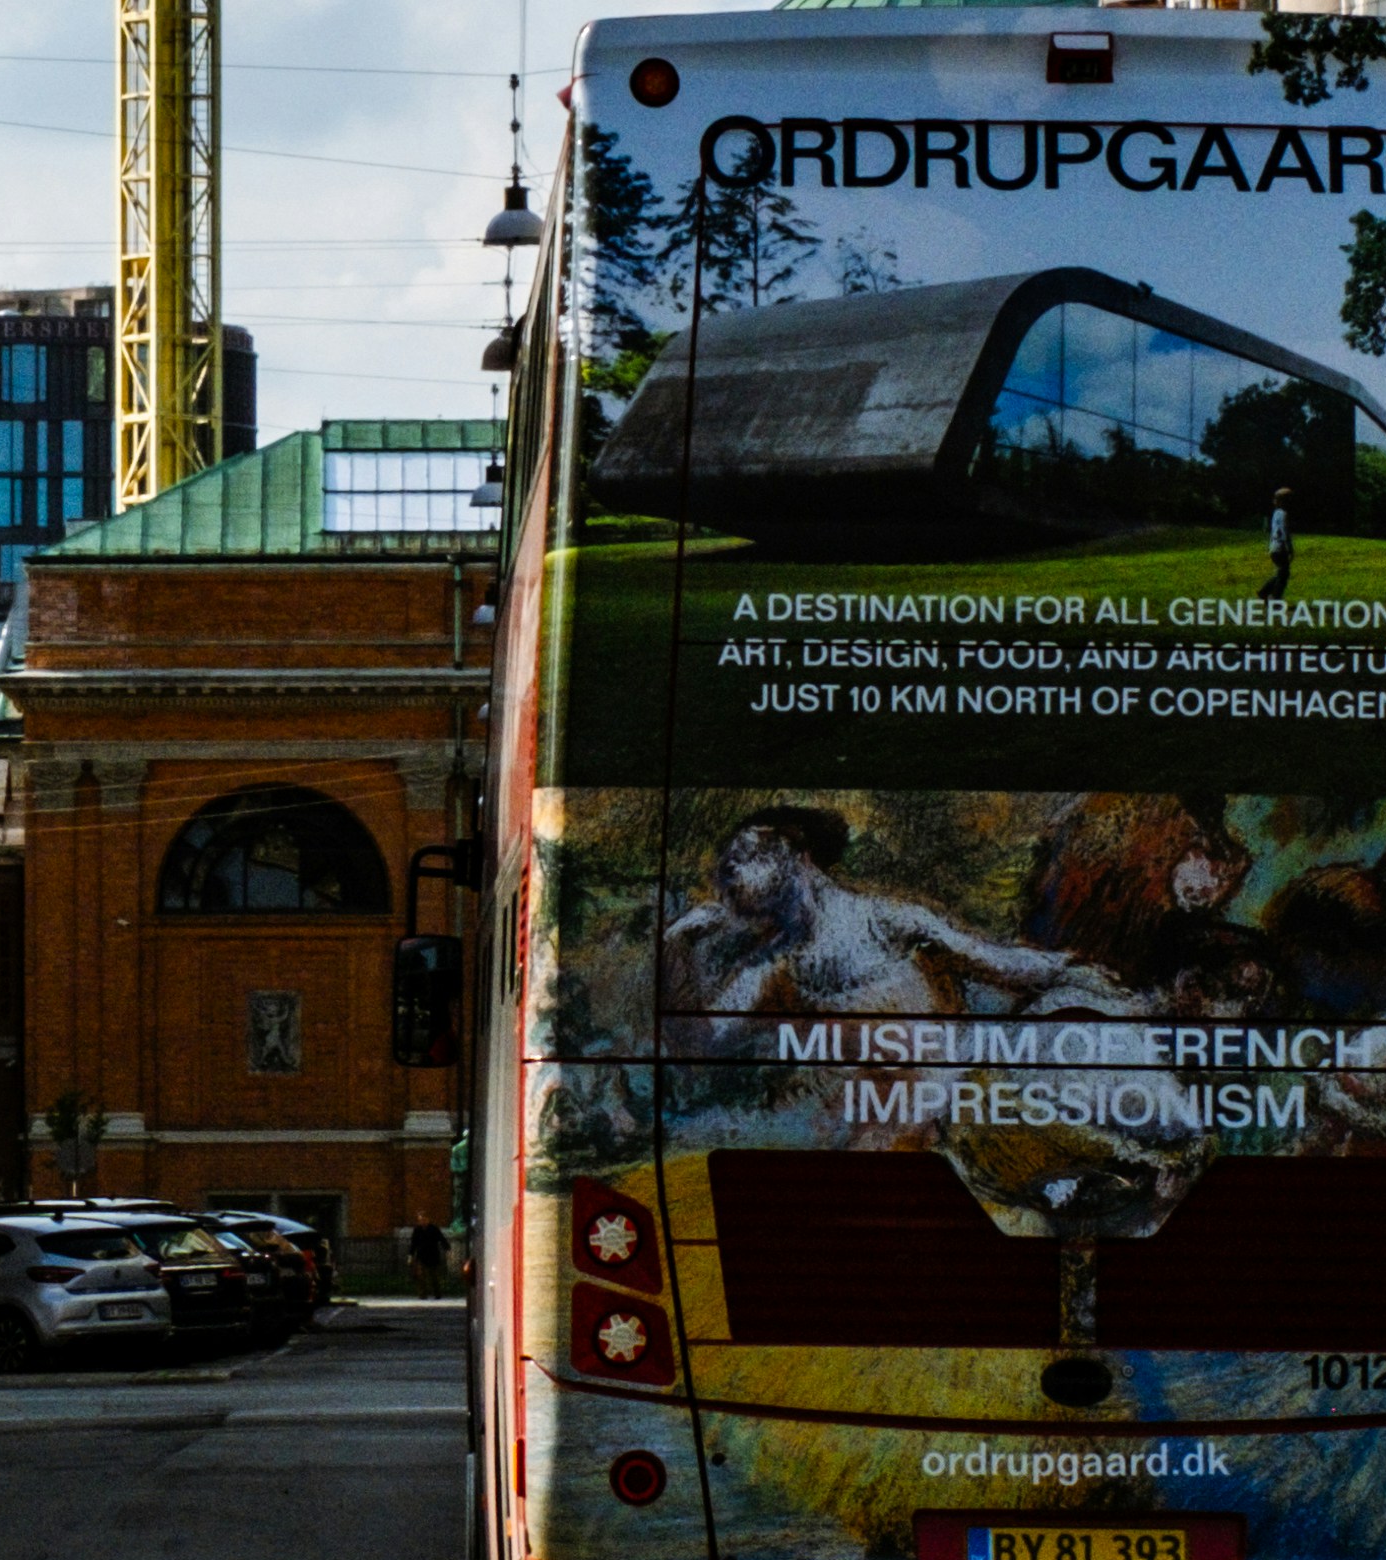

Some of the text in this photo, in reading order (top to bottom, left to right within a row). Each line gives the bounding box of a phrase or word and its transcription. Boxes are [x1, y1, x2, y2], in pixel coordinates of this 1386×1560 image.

[732, 592, 759, 622] A
[767, 593, 1005, 624] DESTINATION
[1015, 595, 1086, 625] FOR
[1094, 595, 1160, 626] ALL
[717, 638, 793, 670] ART,
[802, 638, 949, 672] DESIGN,
[958, 639, 1072, 673] FOOD,
[1078, 641, 1159, 671] AND
[750, 683, 841, 713] JUST
[848, 684, 881, 713] 10
[891, 684, 947, 713] KM
[957, 685, 1081, 715] NORTH
[1091, 686, 1141, 717] OF
[778, 1023, 1373, 1068] MUSEUM OF FRENCH
[843, 1080, 1307, 1129] IMPRESSIONISM
[921, 1442, 1231, 1485] ordrupgaard.dk
